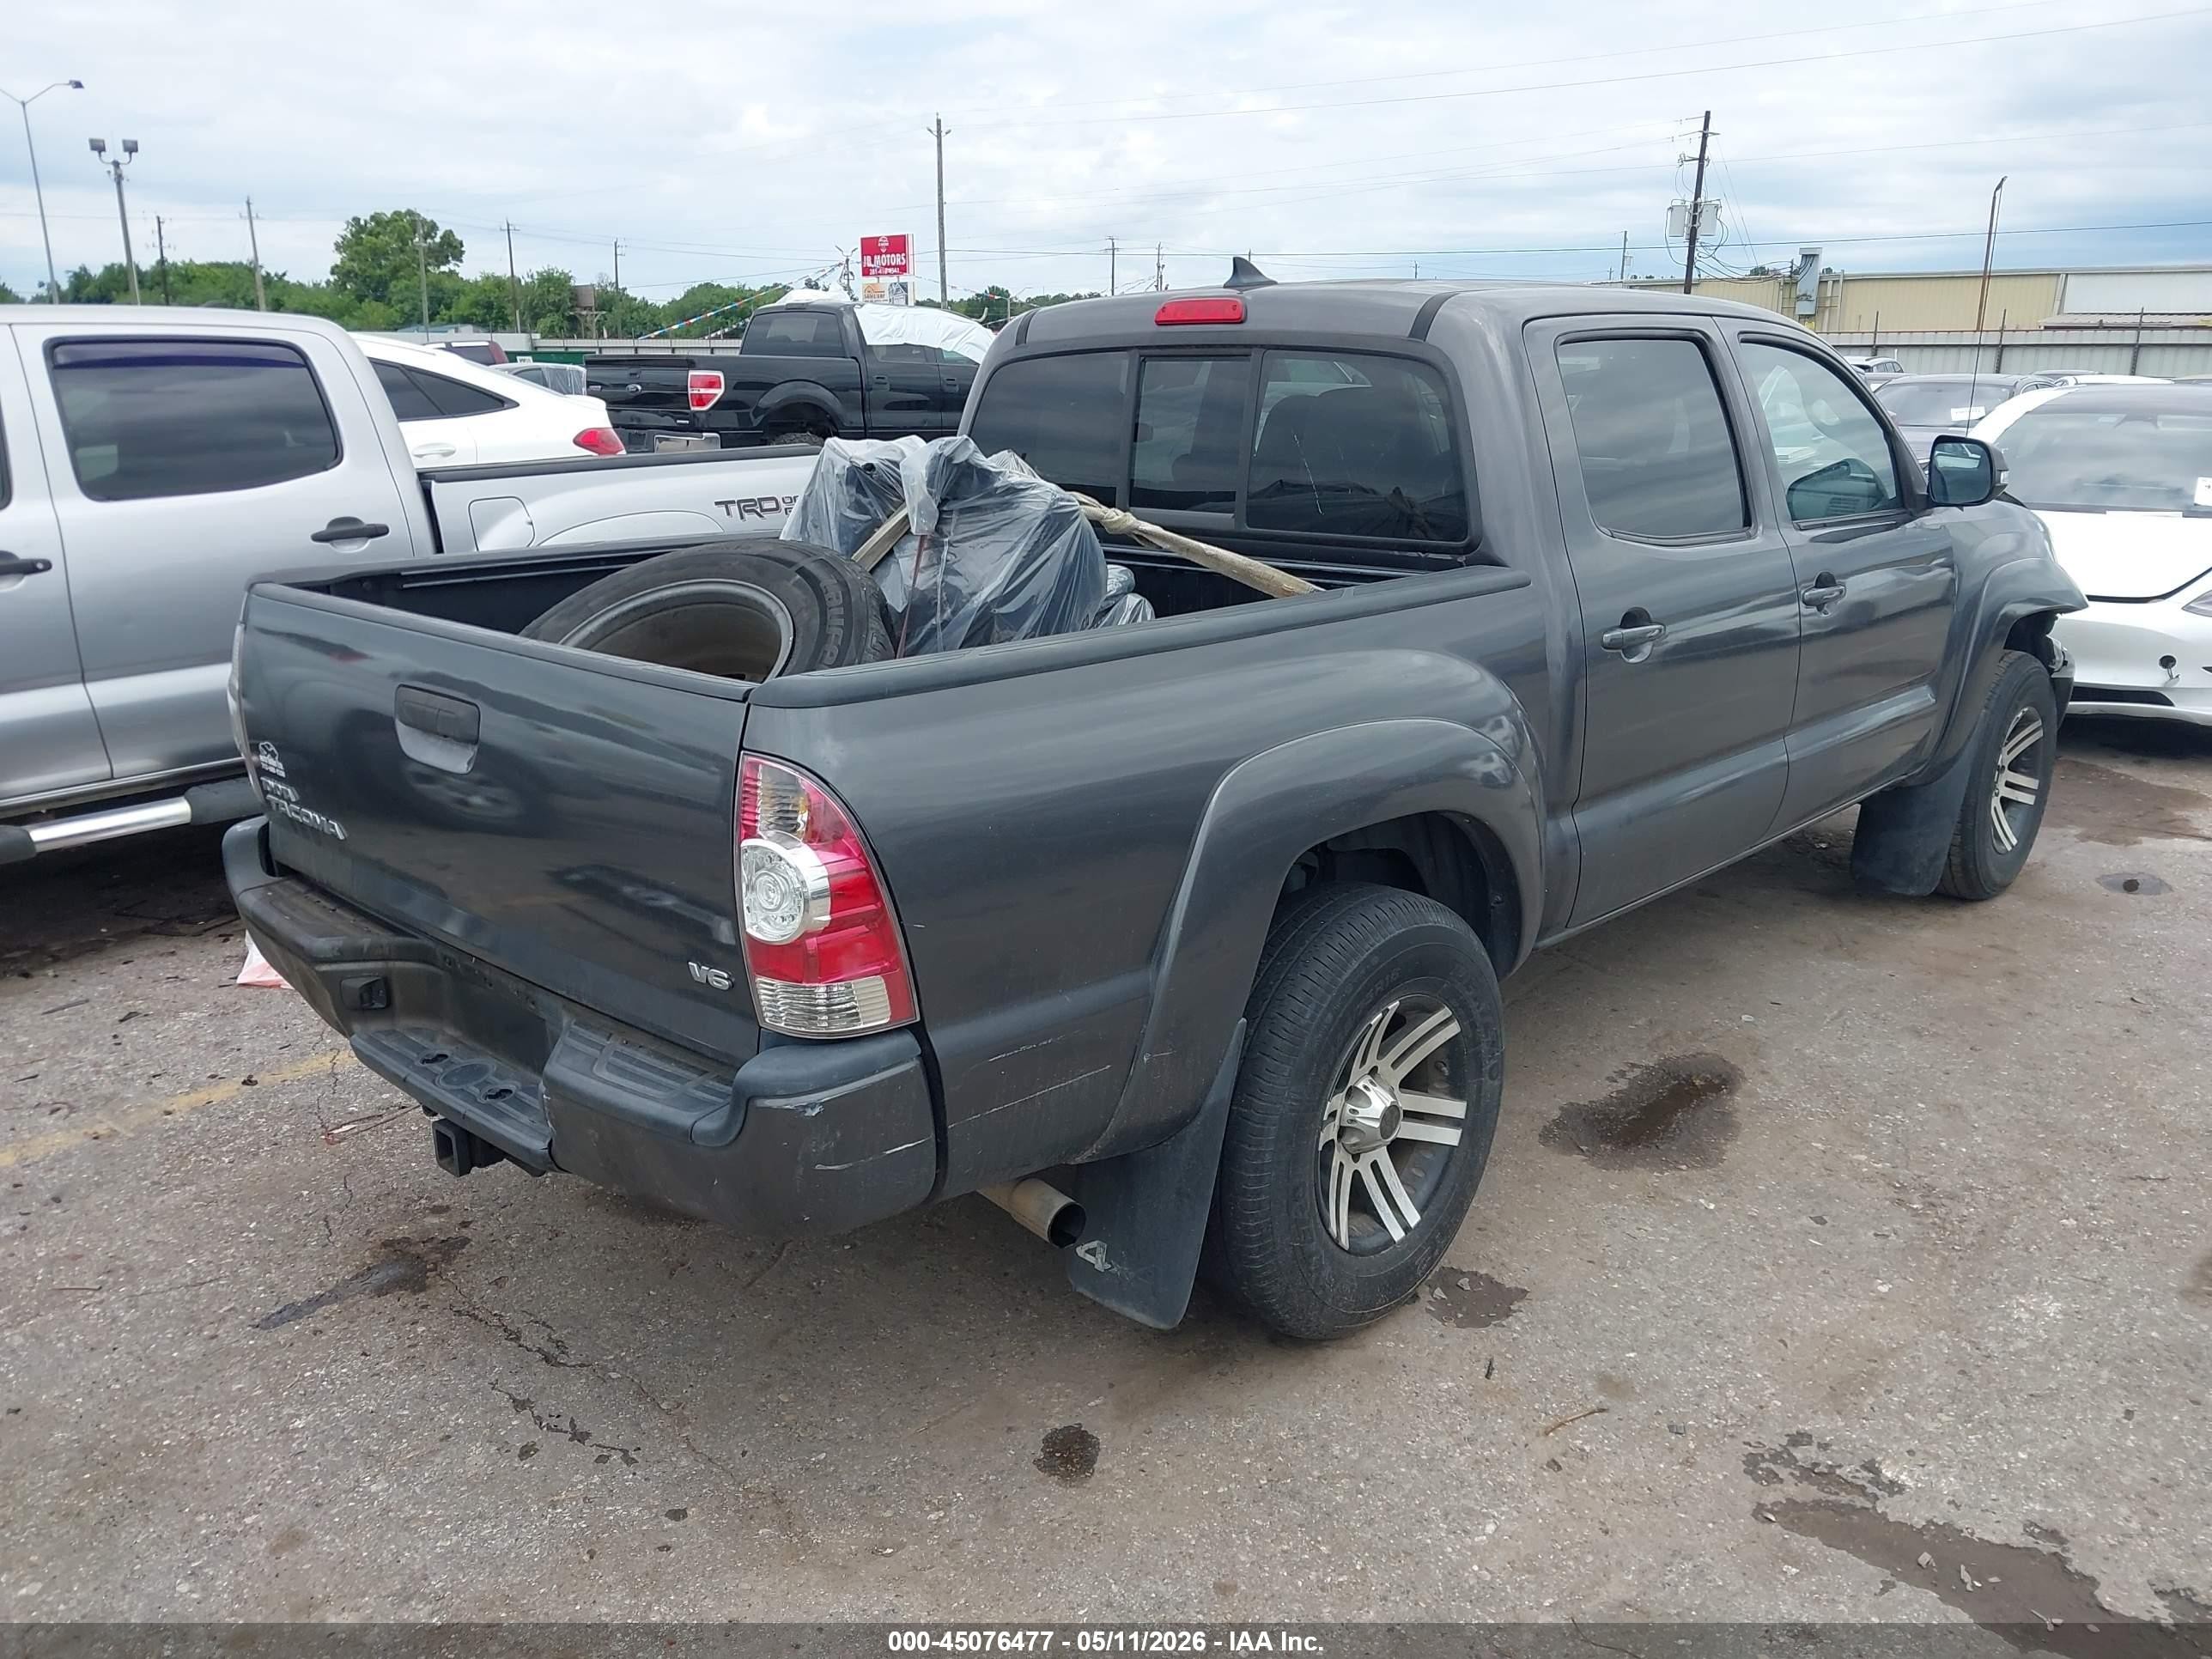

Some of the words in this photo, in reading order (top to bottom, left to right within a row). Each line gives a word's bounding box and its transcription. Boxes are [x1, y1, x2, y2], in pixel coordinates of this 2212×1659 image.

[874, 252, 906, 267] MOTORS
[714, 496, 781, 520] TRD
[266, 794, 347, 840] TACOMA
[688, 961, 733, 990] V6
